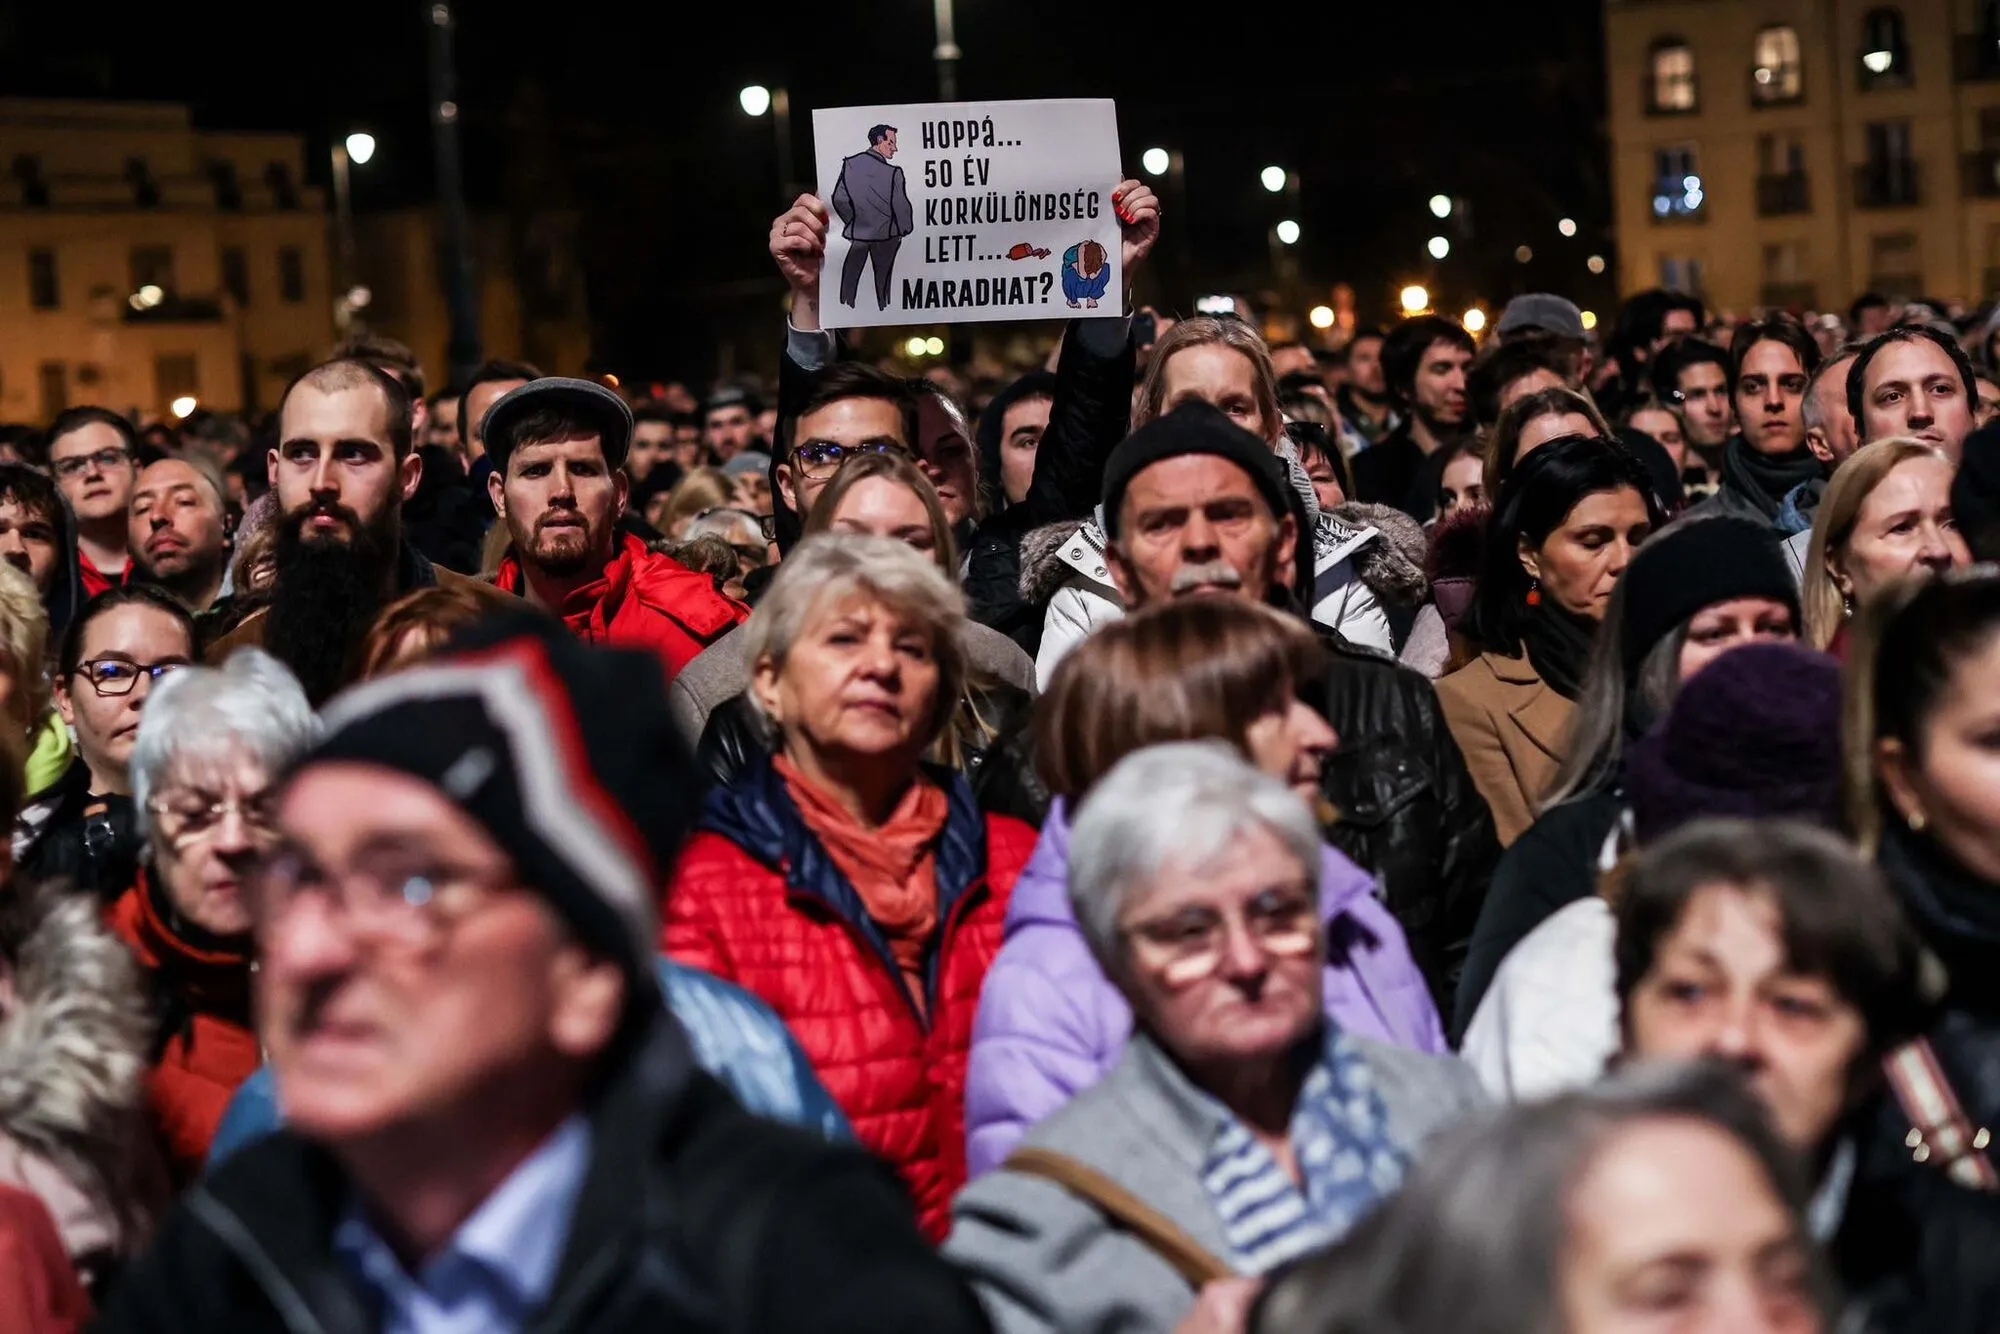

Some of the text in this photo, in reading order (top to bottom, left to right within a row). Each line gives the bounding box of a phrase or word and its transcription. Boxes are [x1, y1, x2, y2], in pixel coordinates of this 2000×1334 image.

[925, 155, 990, 188] 50 ÉV
[925, 188, 1099, 226] KORKÜLÖNBSÉG
[925, 234, 1002, 264] LETT...
[902, 272, 1053, 310] MARADHAT?
